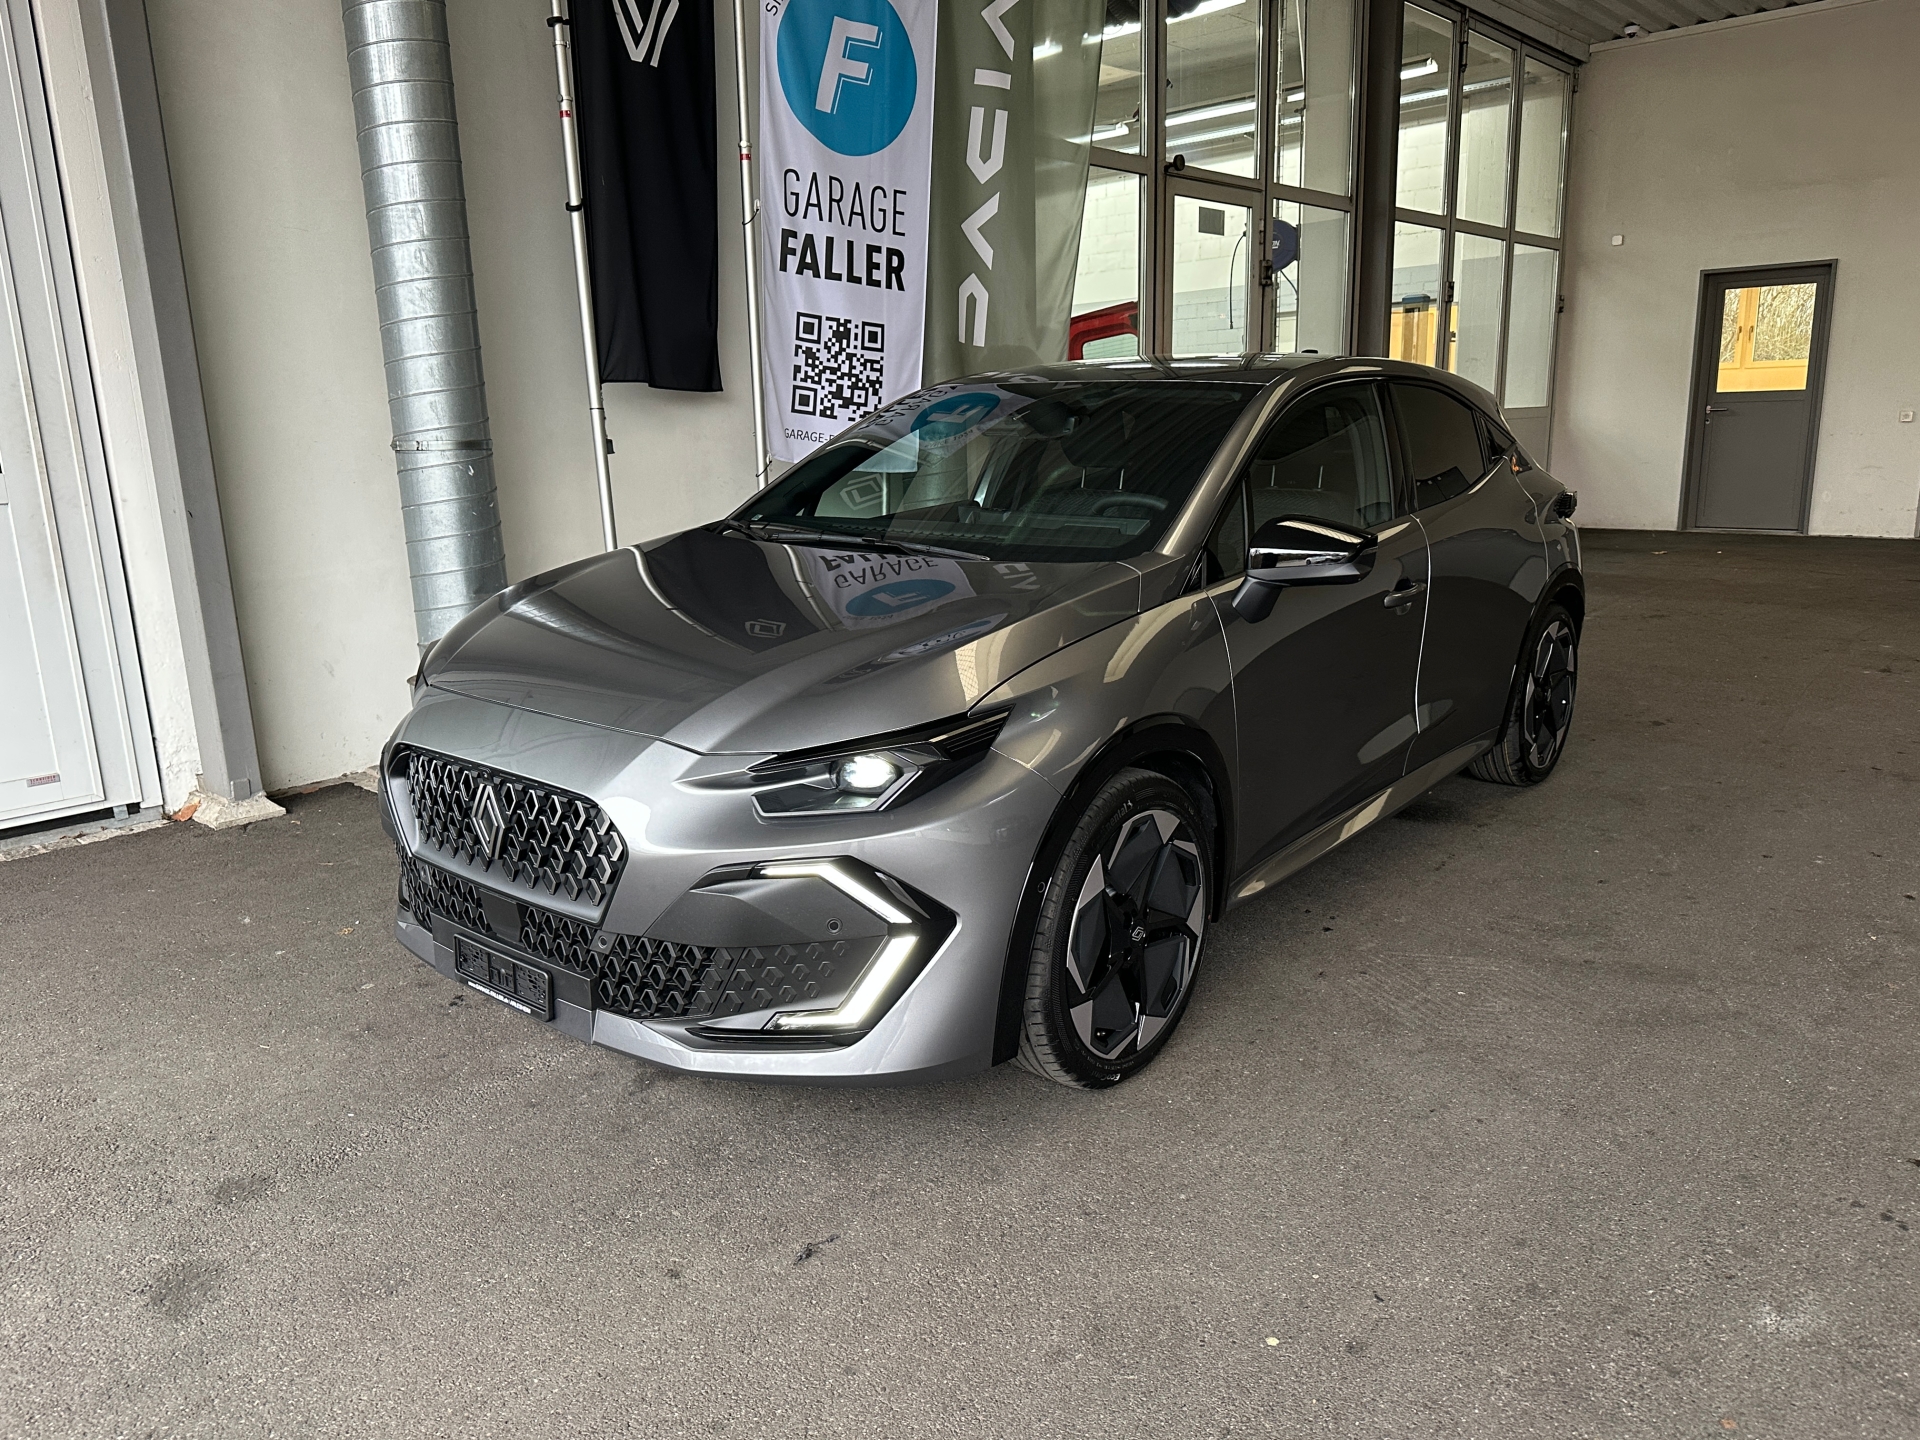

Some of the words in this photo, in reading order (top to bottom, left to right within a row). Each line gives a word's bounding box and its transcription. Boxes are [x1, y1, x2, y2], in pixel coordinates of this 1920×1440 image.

[815, 15, 882, 115] F
[783, 168, 907, 237] GARAGE
[958, 0, 1020, 348] DACIA
[779, 227, 905, 291] FALLER
